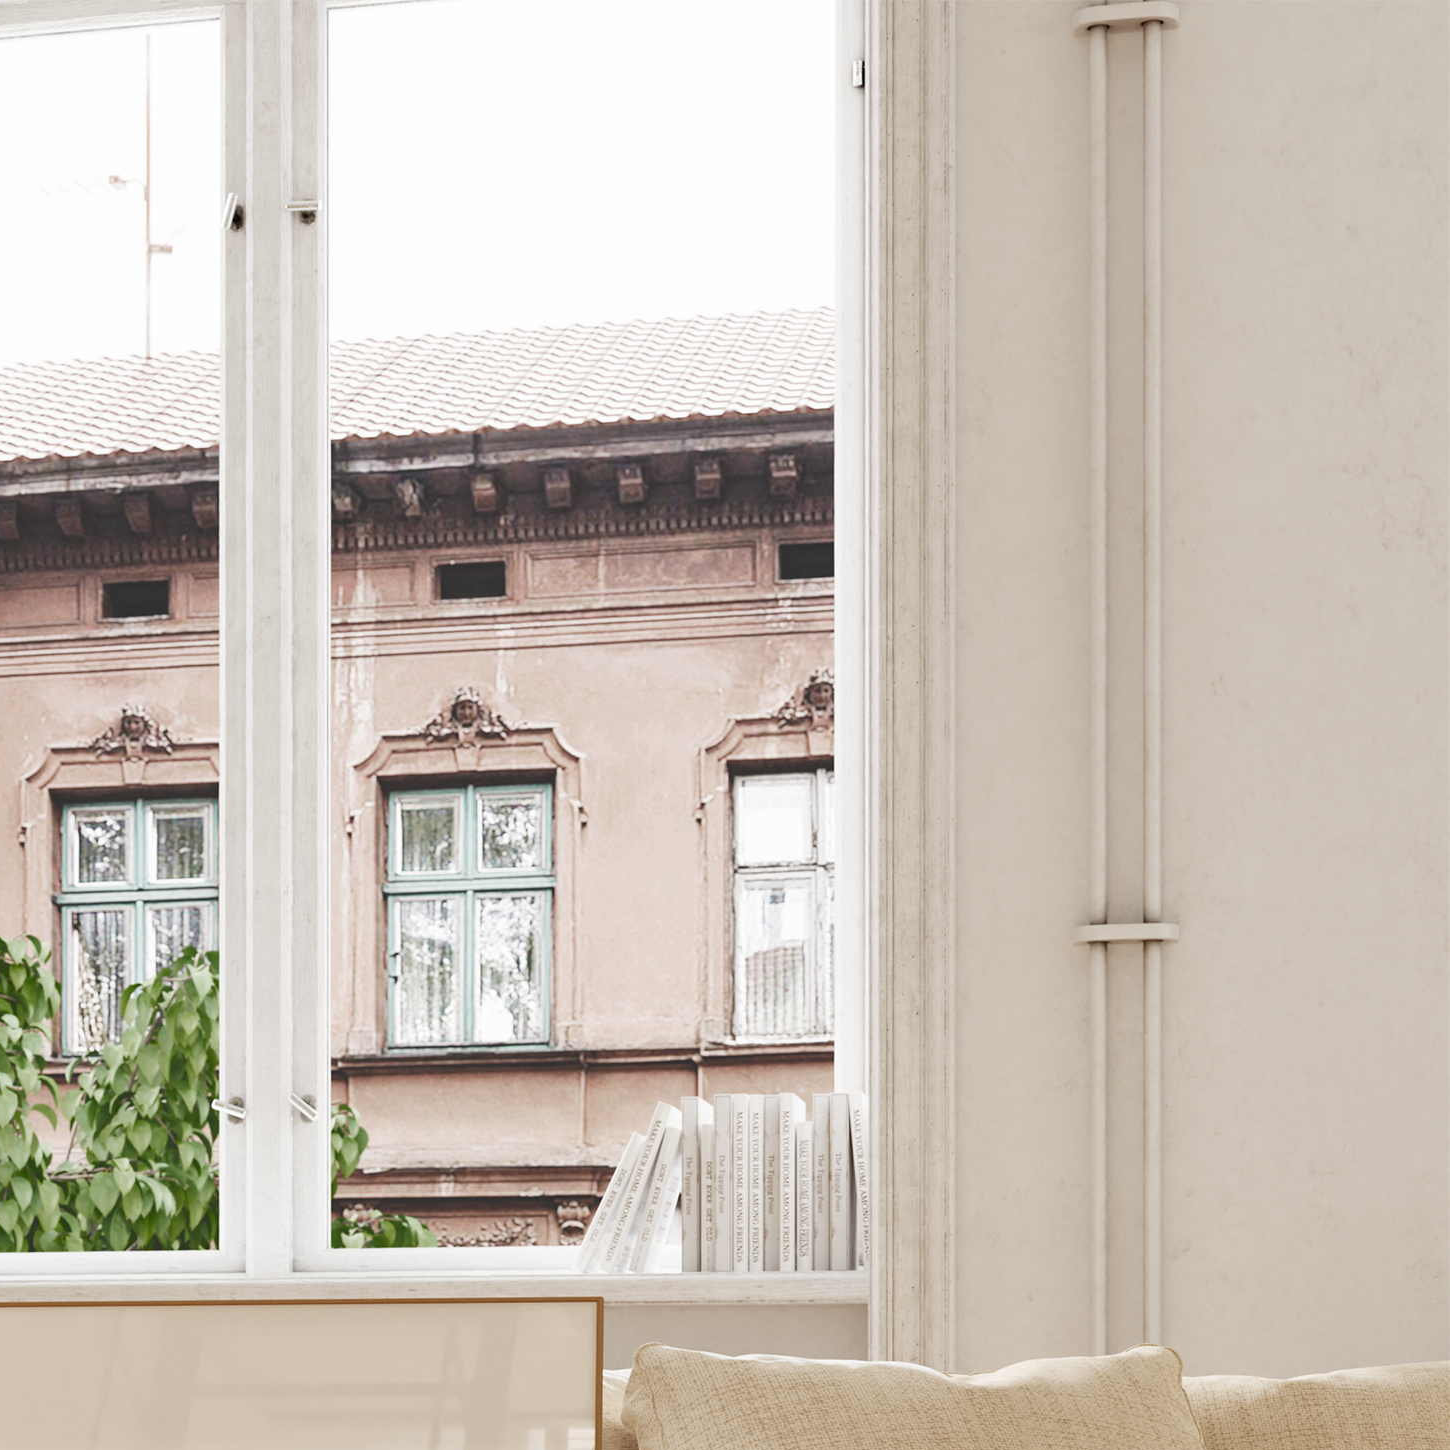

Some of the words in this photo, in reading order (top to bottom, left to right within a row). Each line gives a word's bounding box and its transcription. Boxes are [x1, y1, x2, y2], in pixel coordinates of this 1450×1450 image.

[649, 1119, 662, 1143] MAKE
[640, 1143, 655, 1167] YOUR
[799, 1139, 809, 1159] MAKE
[856, 1135, 864, 1161] YOUR
[627, 1166, 645, 1195] HOME
[799, 1160, 809, 1178] YOUR
[858, 1161, 866, 1189] HOME
[605, 1191, 617, 1209] EVER
[651, 1186, 661, 1206] EVER
[799, 1178, 809, 1200] HOME
[617, 1194, 633, 1227] AMONG
[646, 1209, 655, 1224] GET
[799, 1200, 809, 1228] AMONG
[860, 1189, 869, 1223] AMONG
[597, 1211, 607, 1226] GET
[589, 1229, 599, 1243] OLD
[606, 1226, 624, 1262] FRIENDS
[641, 1227, 650, 1242] OLD
[799, 1229, 809, 1258] FRIENDS
